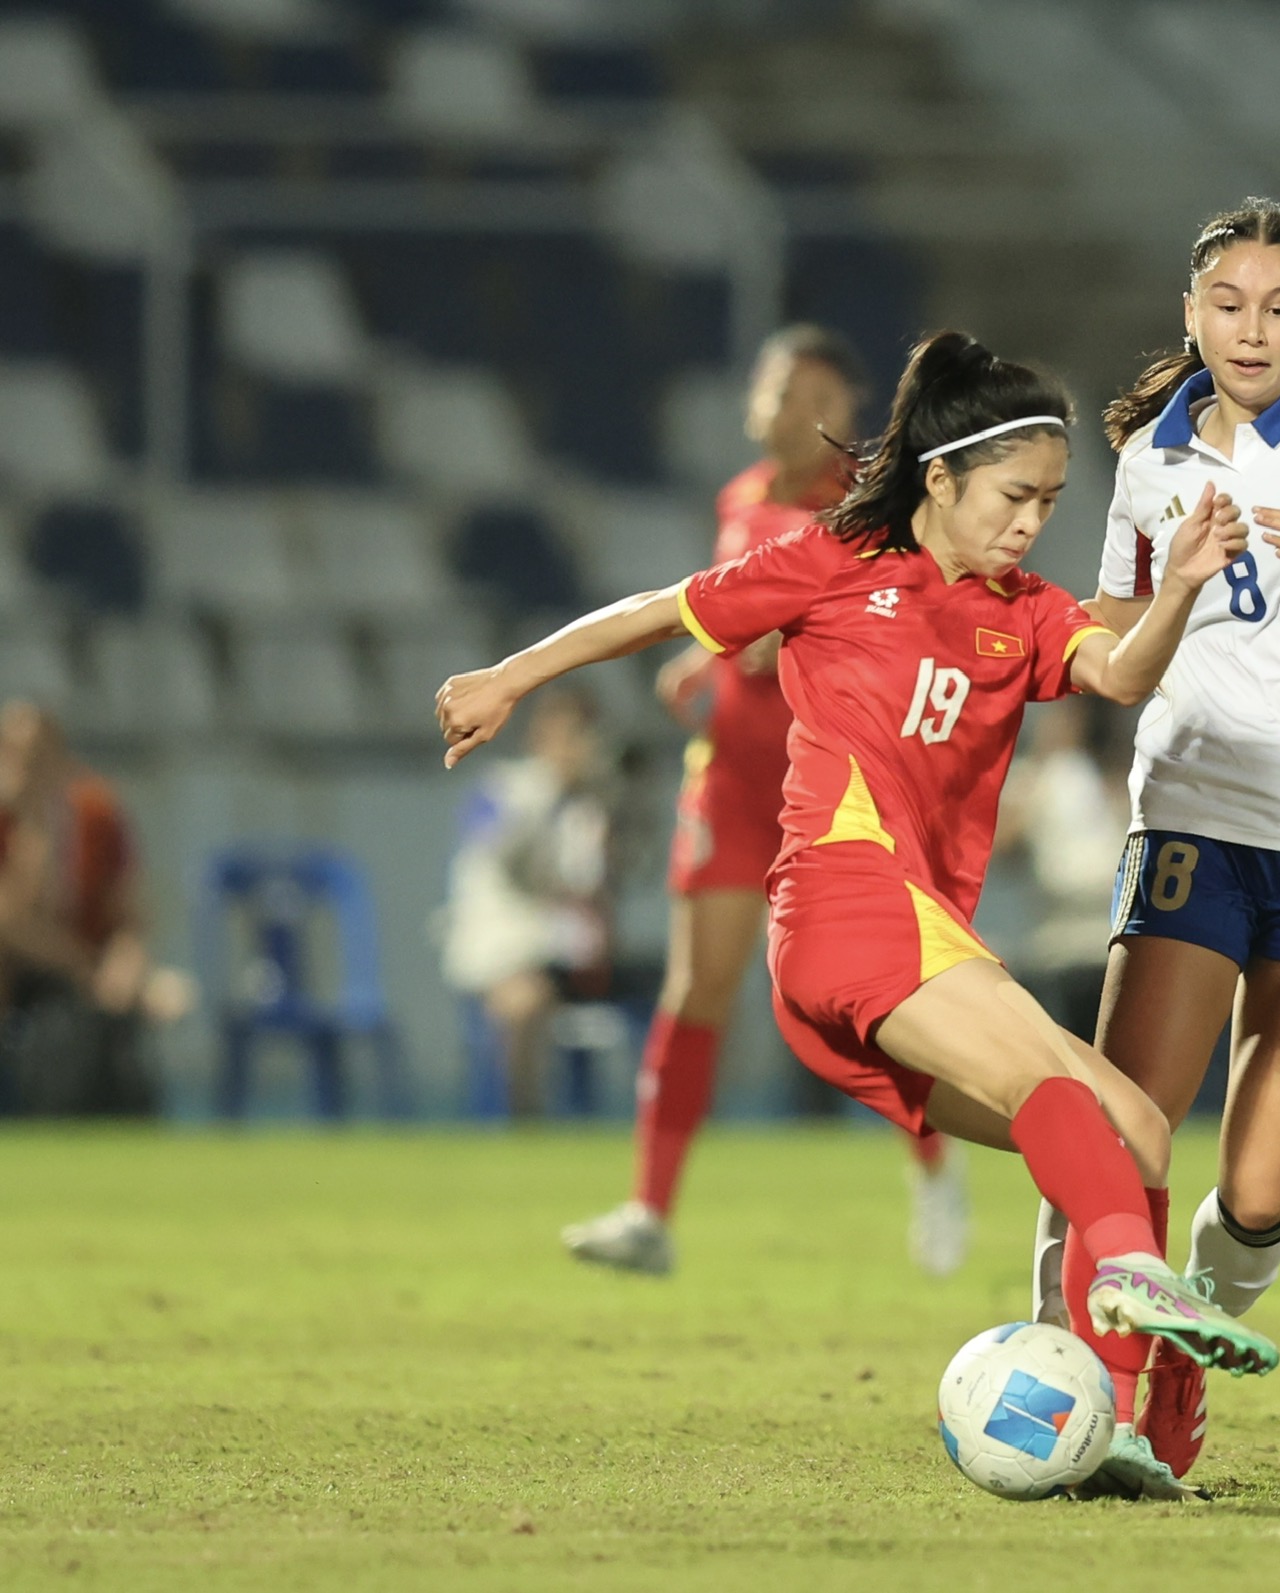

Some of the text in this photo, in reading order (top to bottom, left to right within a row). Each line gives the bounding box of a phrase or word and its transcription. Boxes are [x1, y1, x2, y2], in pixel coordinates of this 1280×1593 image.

[1223, 550, 1267, 623] 8
[900, 657, 971, 745] 19
[1151, 841, 1200, 912] 8
[1072, 1413, 1098, 1463] molten
